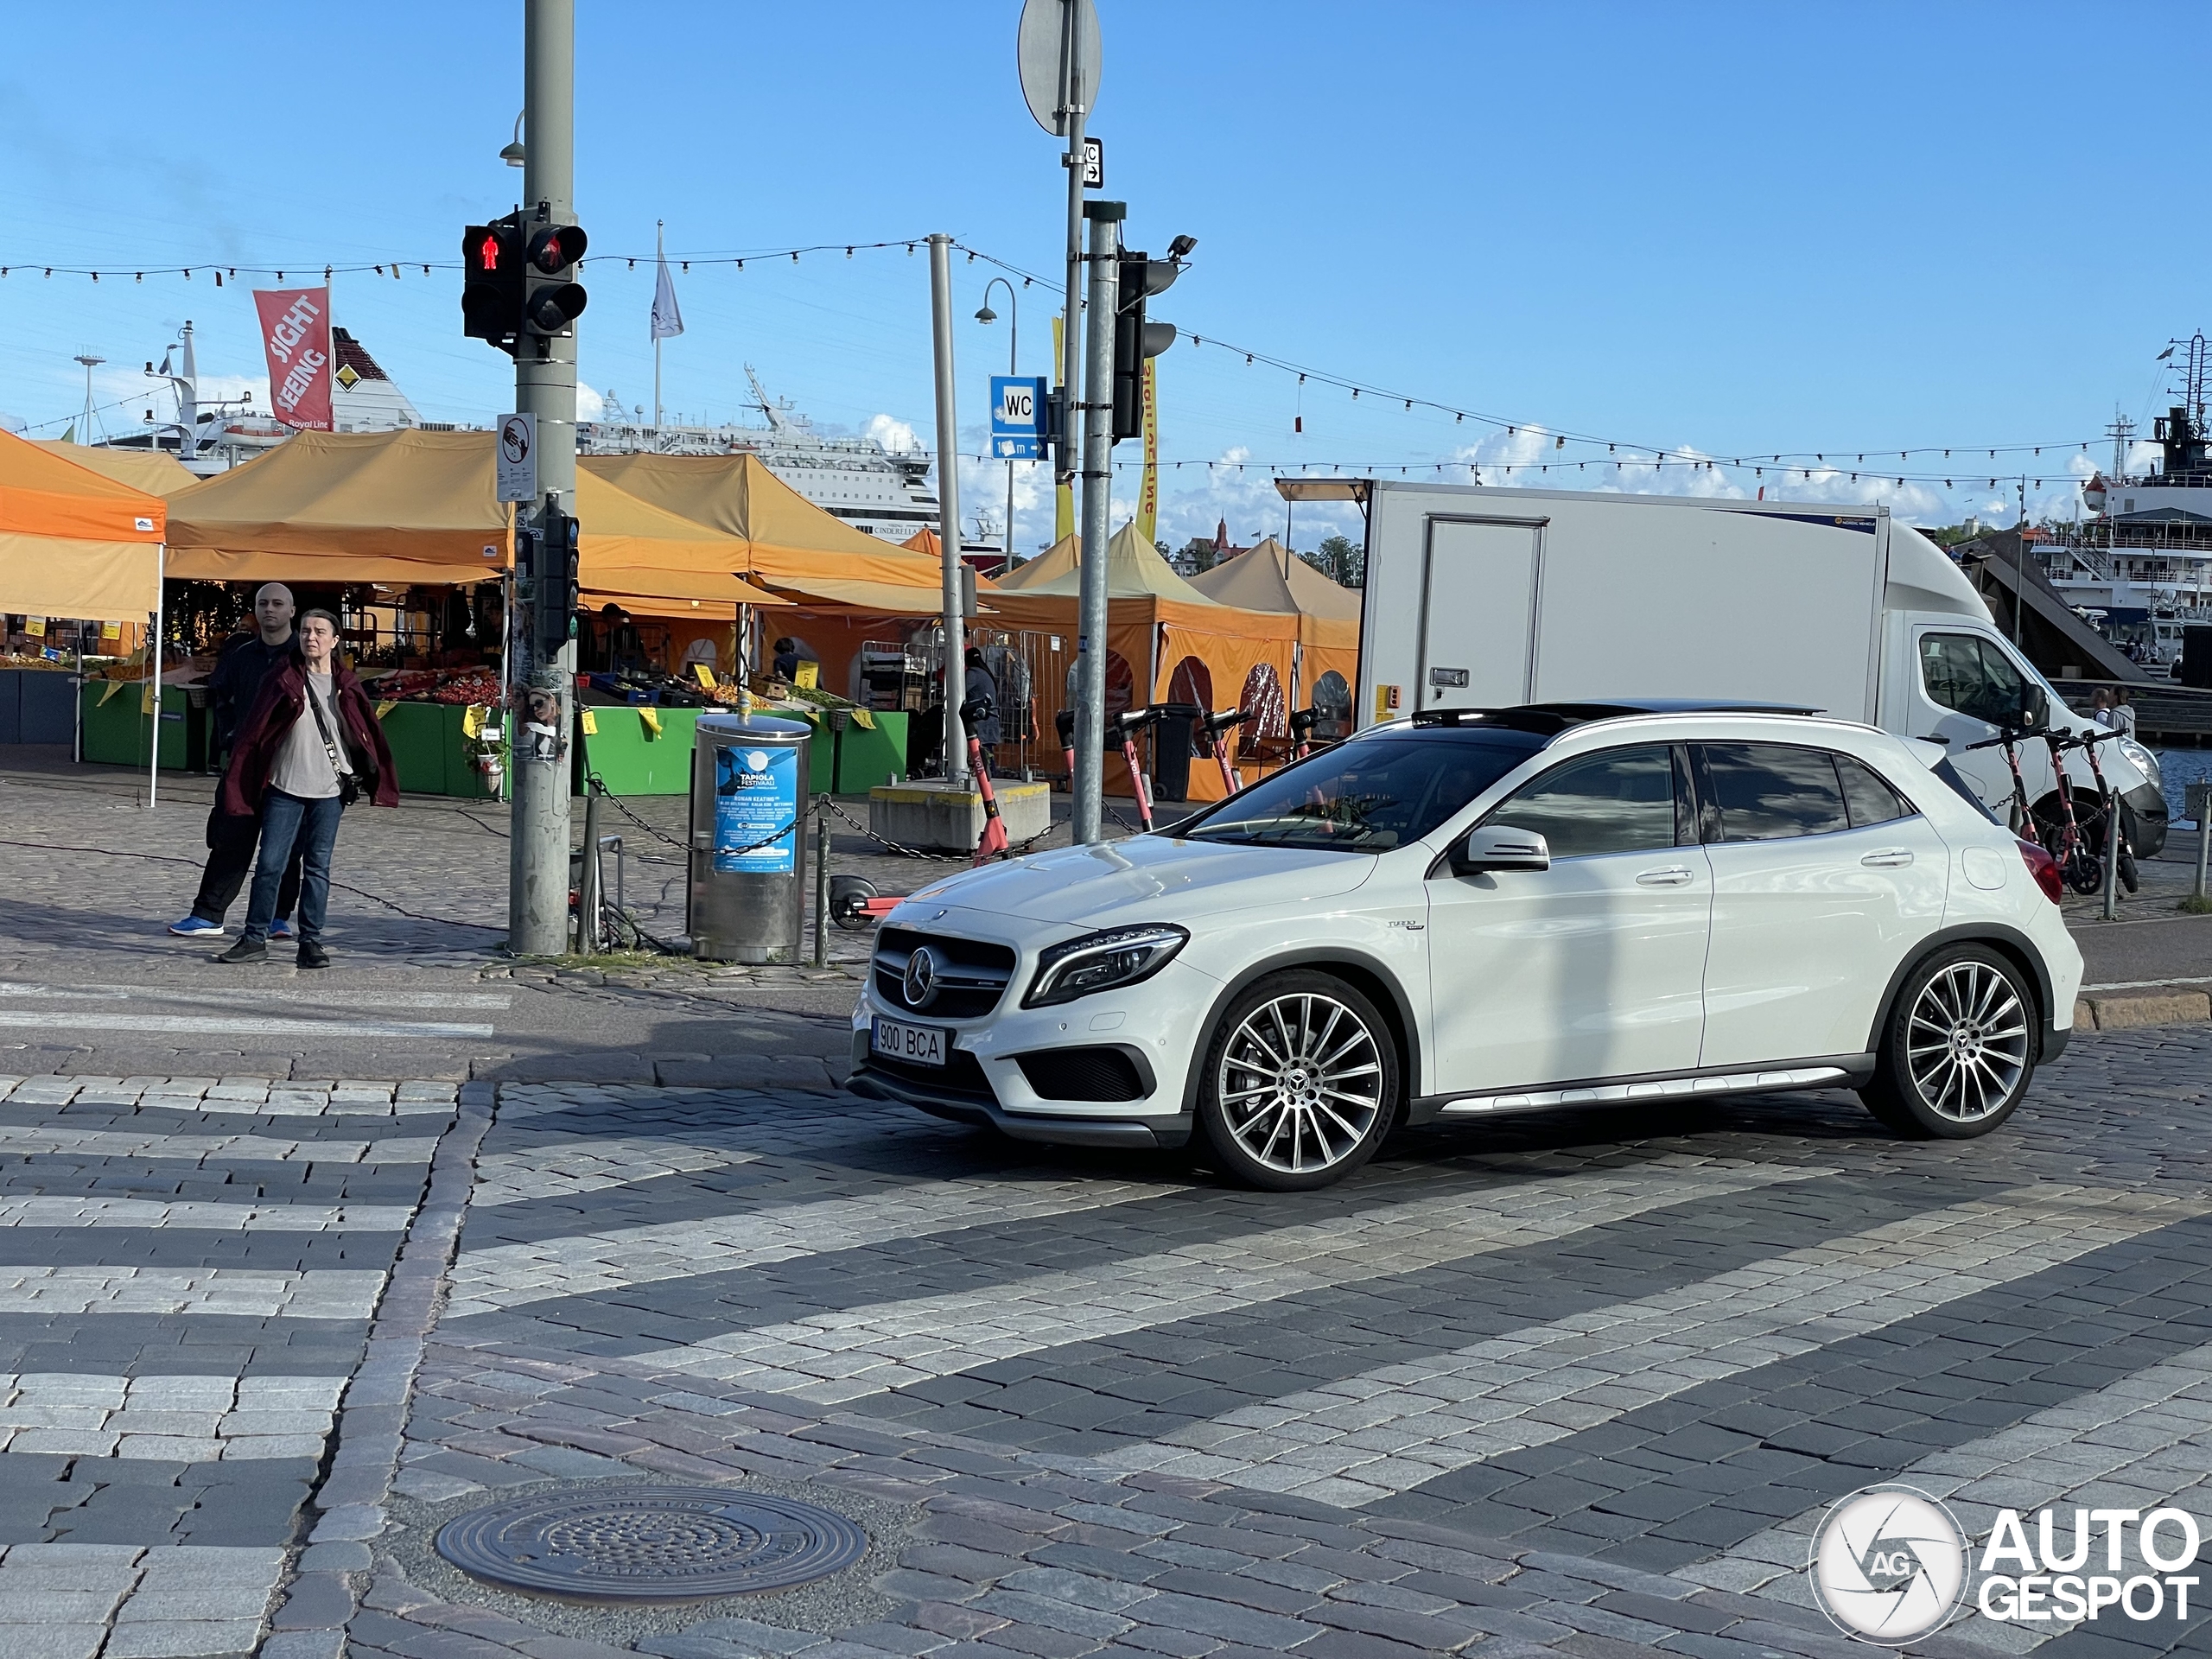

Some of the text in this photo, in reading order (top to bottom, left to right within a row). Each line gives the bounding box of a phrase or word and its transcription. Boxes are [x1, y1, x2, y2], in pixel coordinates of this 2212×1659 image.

[270, 294, 321, 364] SIGHT
[276, 348, 327, 413] SEEING
[1005, 395, 1033, 416] WC
[289, 419, 328, 430] Royal Line
[880, 1023, 940, 1060] 900 BCA
